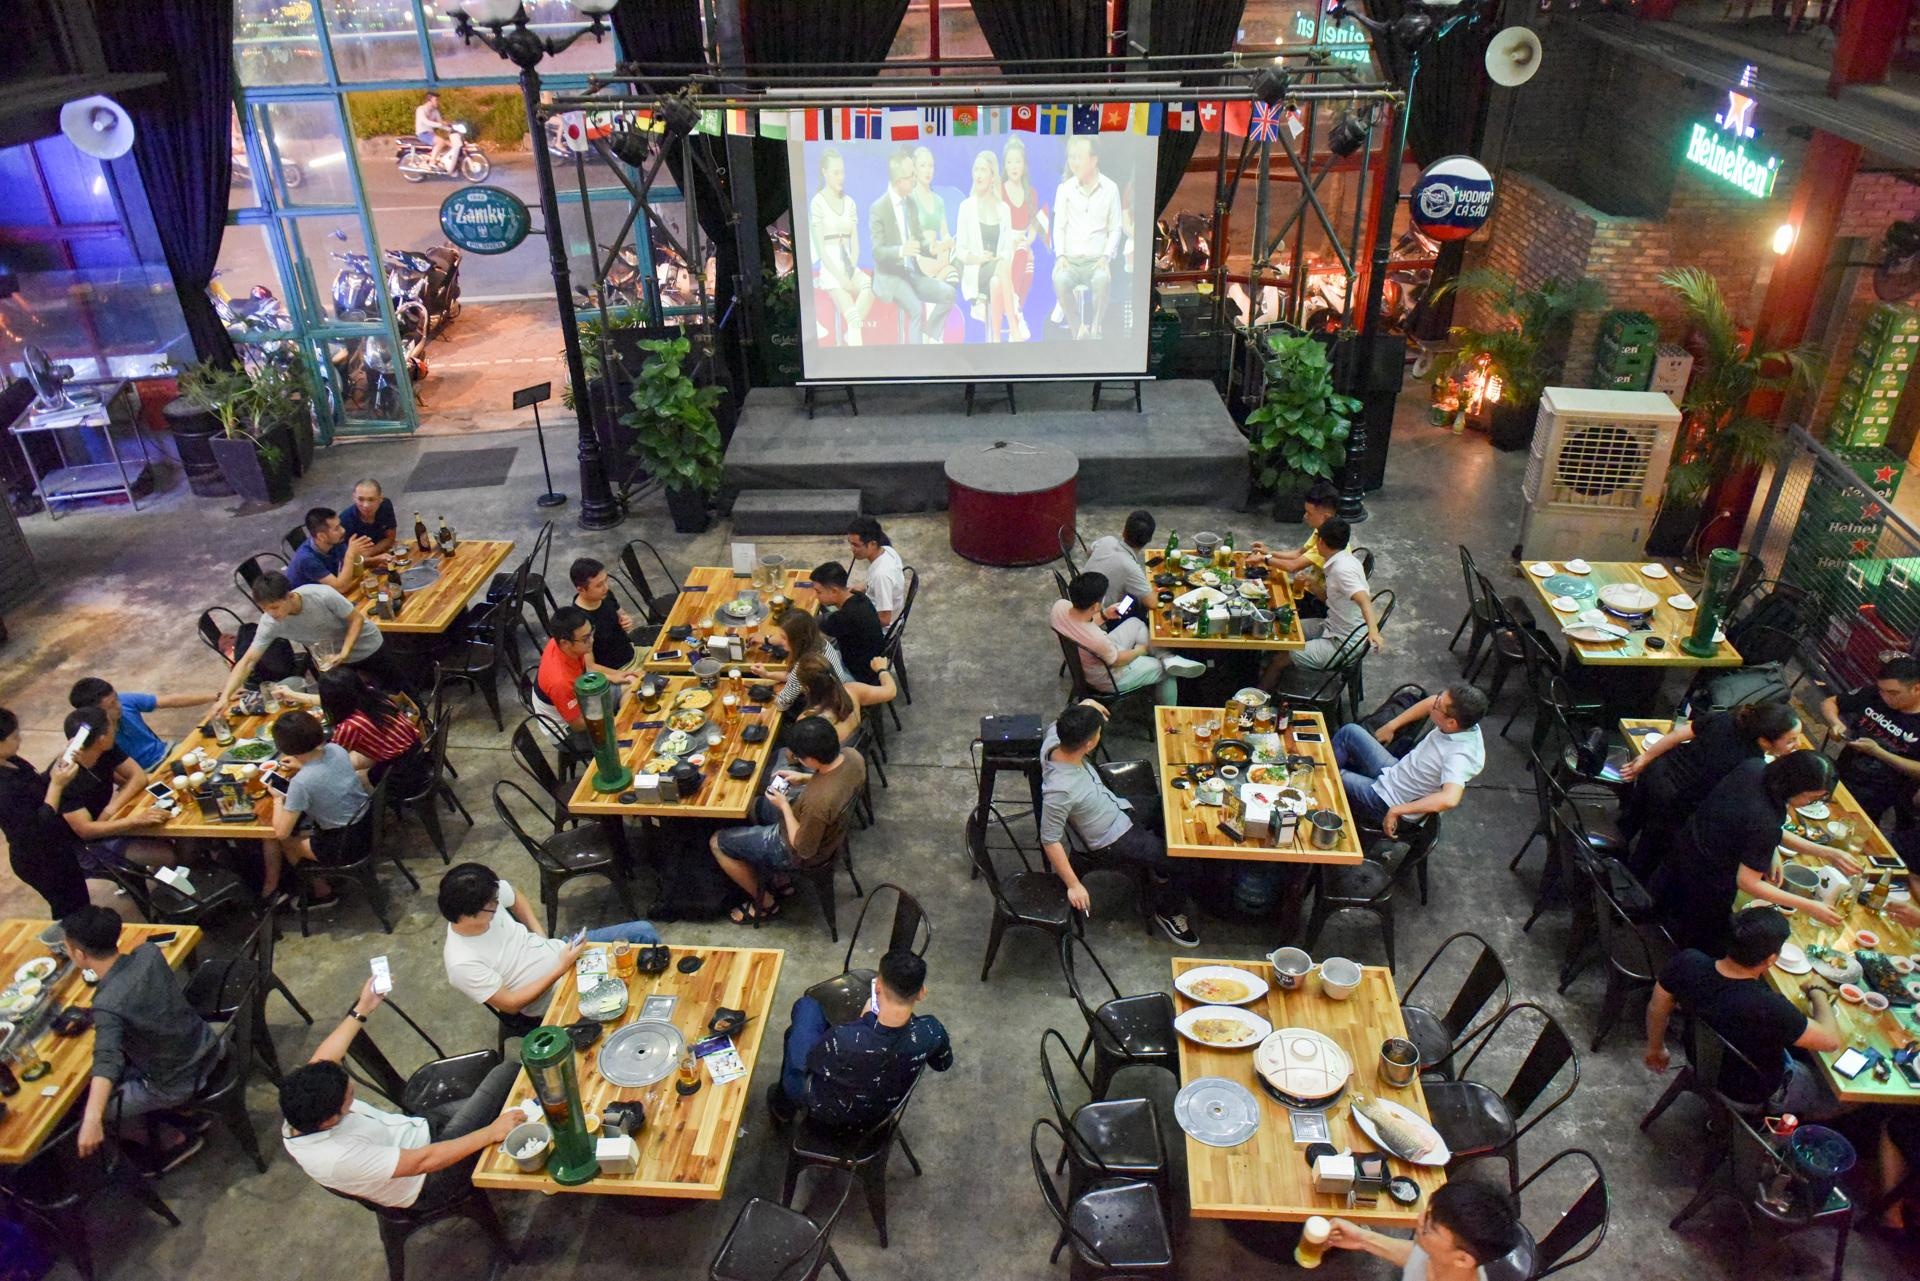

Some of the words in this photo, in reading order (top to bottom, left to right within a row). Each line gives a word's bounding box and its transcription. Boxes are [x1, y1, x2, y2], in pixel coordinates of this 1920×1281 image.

[1686, 122, 1770, 198] Heineken
[1458, 190, 1490, 203] VODKA
[454, 203, 506, 227] Zamky
[1864, 706, 1903, 737] adidas
